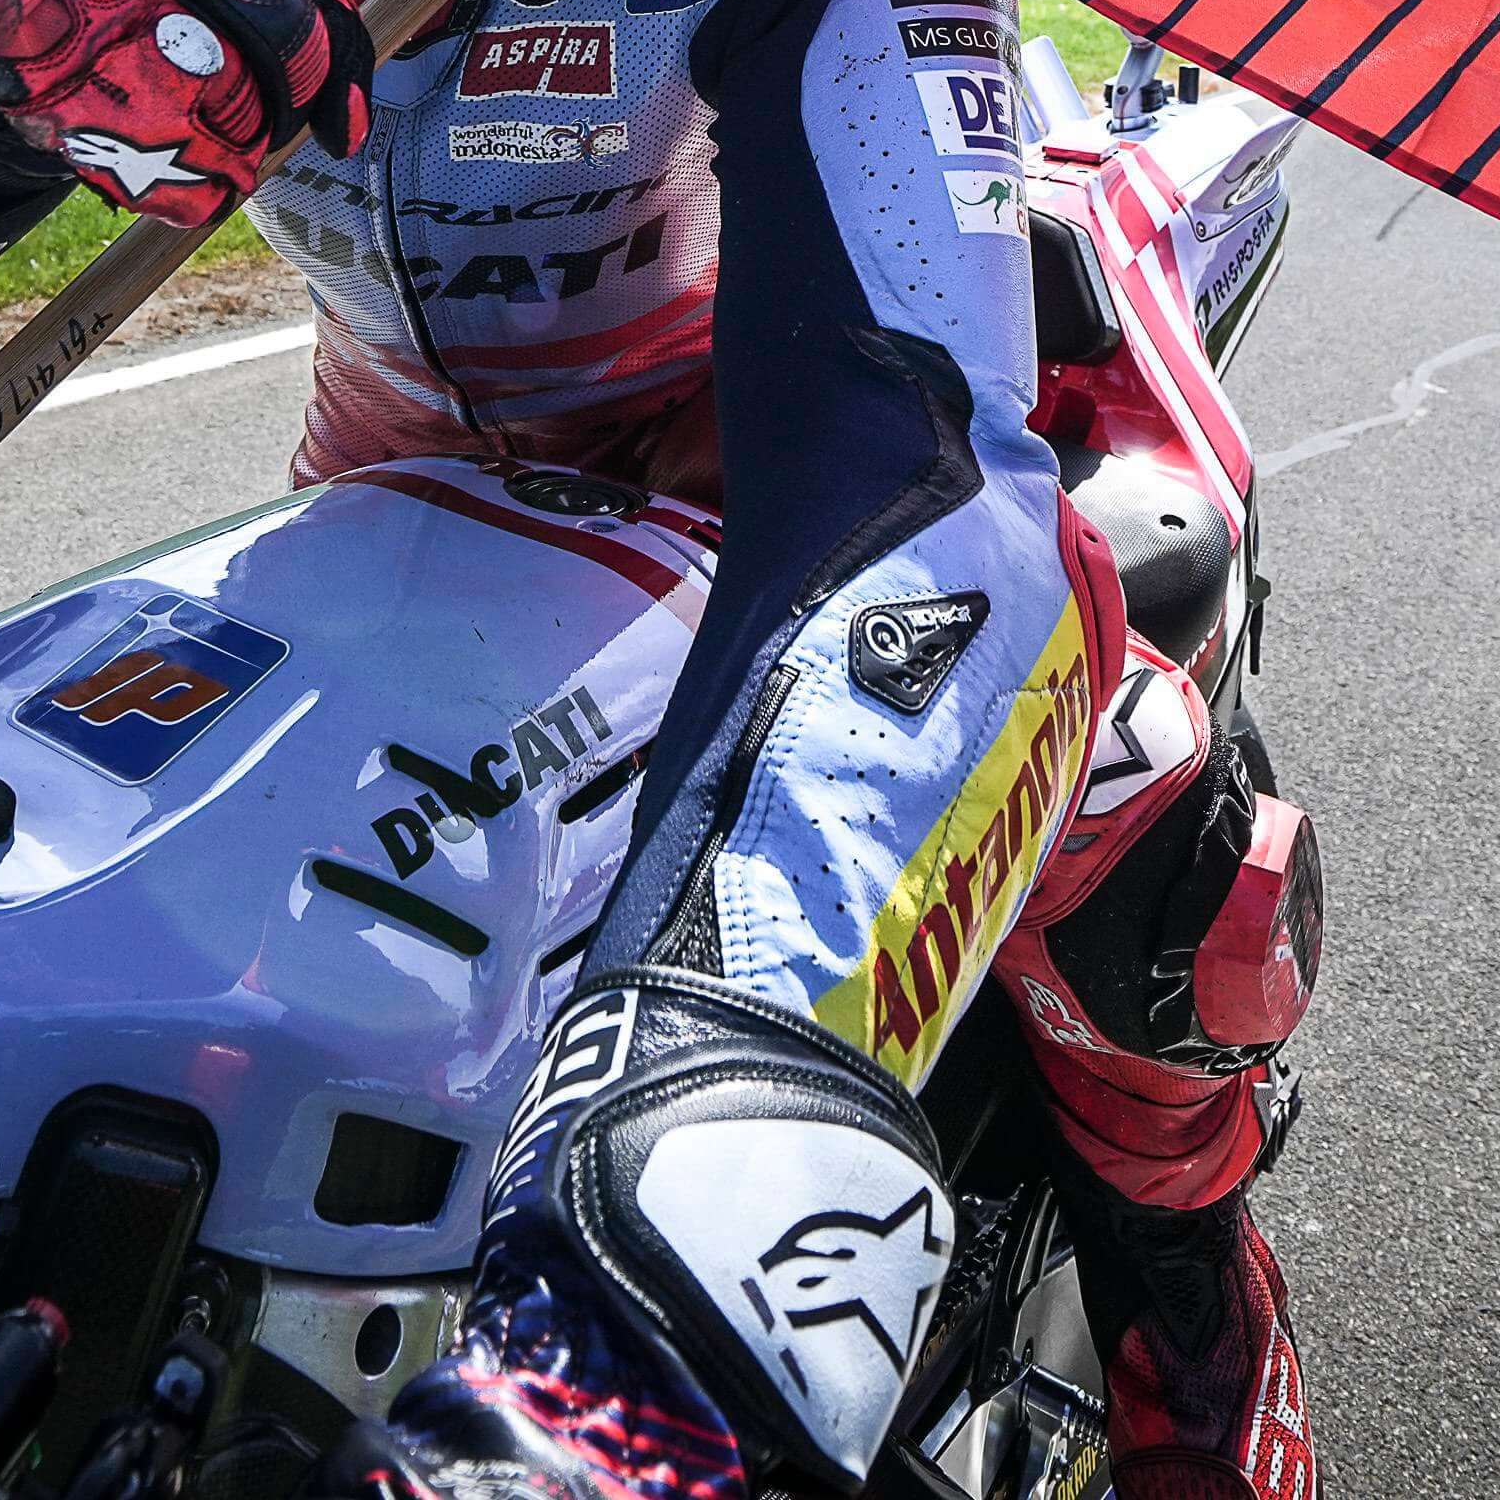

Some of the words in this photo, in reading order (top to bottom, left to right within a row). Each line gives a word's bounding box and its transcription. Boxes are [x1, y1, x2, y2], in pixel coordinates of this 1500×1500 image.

[480, 35, 601, 70] ASPIRA
[452, 122, 534, 142] wonderful
[452, 140, 563, 160] indonesia
[49, 650, 231, 727] IP
